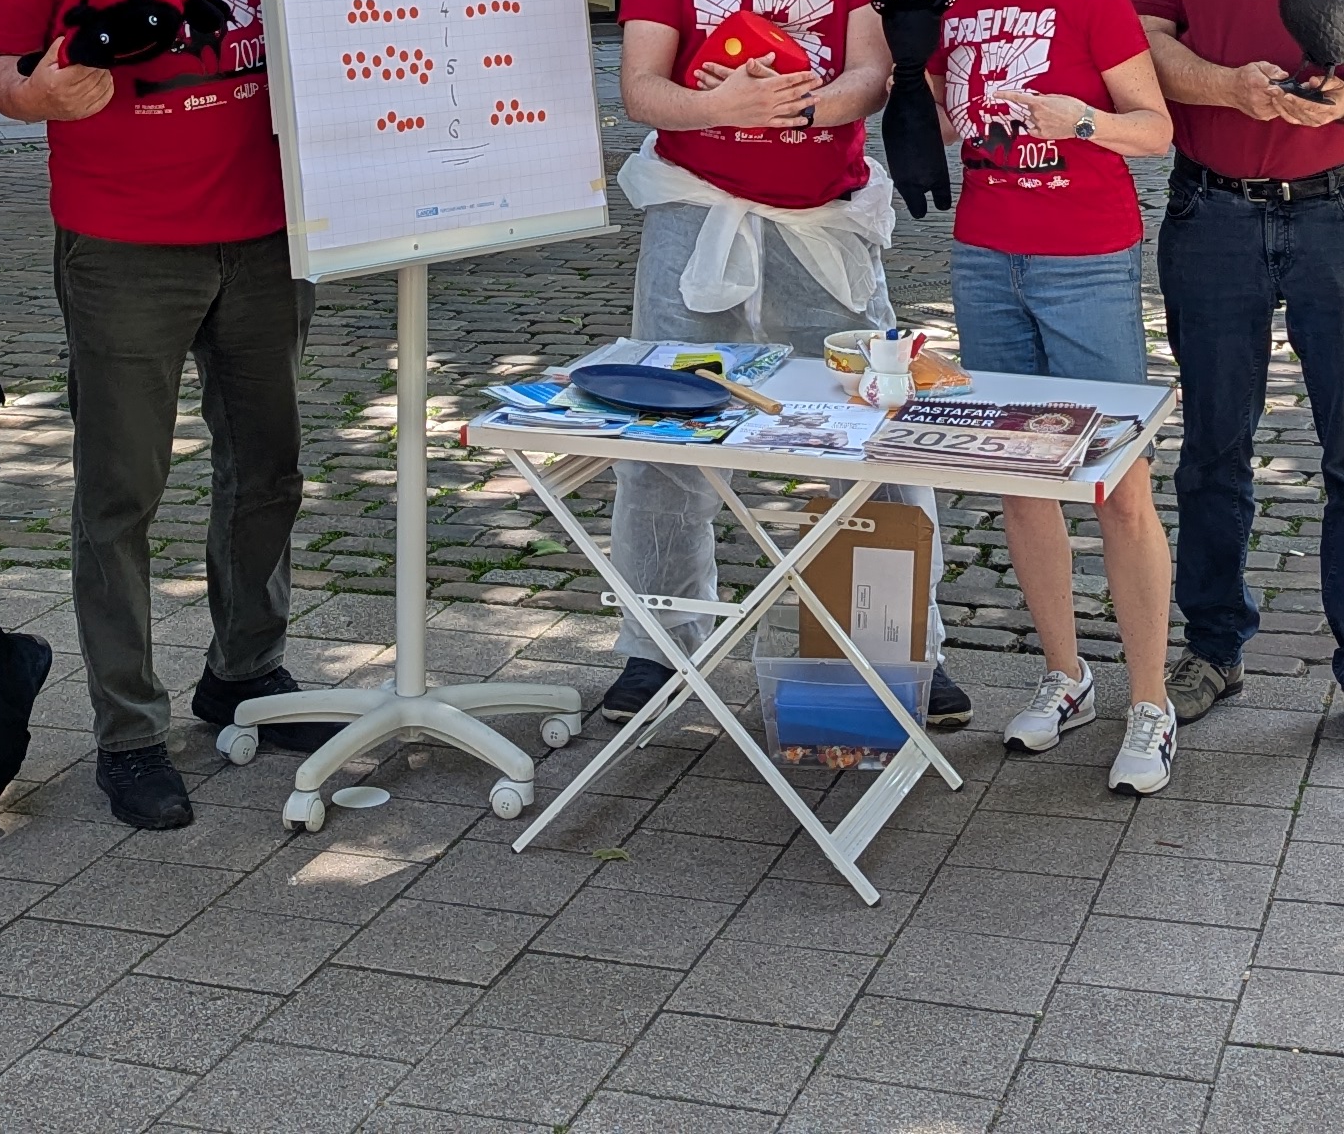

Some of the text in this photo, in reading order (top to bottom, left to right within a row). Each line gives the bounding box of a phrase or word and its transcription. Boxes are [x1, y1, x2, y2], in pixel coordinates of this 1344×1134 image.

[440, 1, 450, 19] 4
[943, 6, 1056, 48] FREITAG
[446, 58, 458, 76] 5
[448, 118, 461, 140] 6
[1017, 140, 1059, 169] 2025
[902, 413, 995, 428] KALENDER
[908, 404, 1007, 418] PASTAFARI-
[879, 427, 1011, 454] 2025
